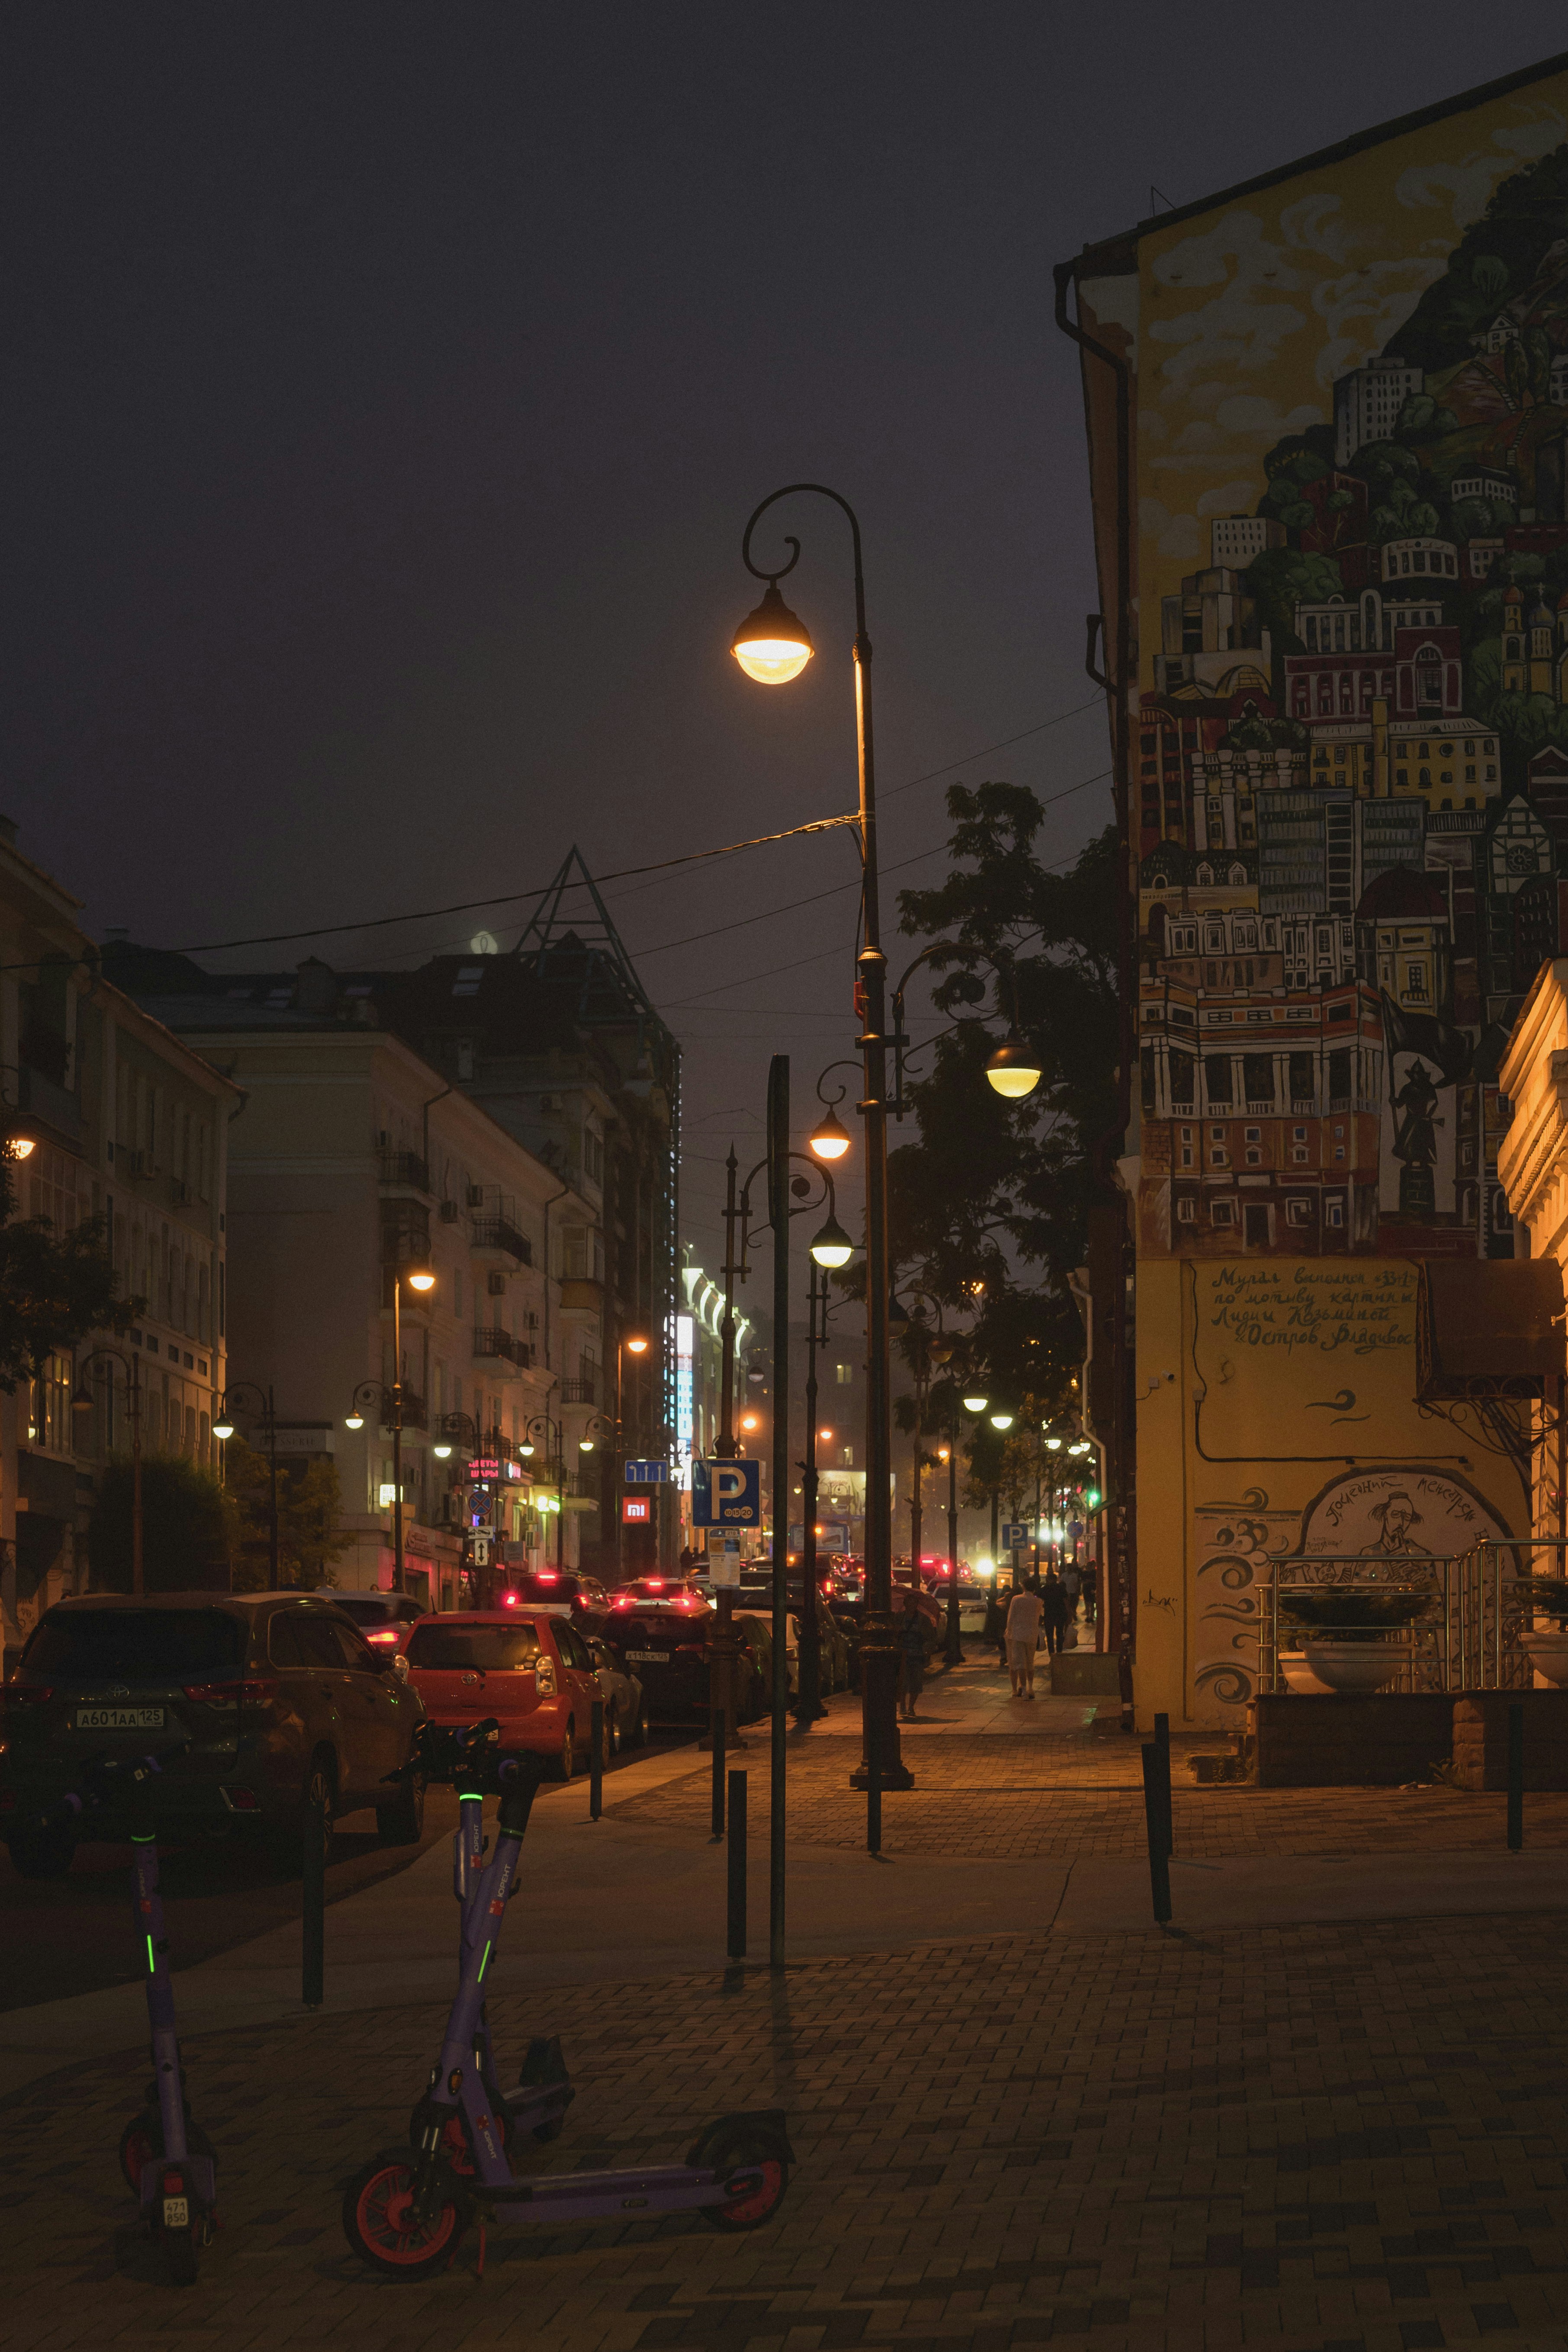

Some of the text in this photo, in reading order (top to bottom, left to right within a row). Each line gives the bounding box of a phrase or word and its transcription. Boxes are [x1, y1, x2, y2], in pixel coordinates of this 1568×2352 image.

[1212, 1266, 1281, 1293] Мурал
[1214, 1291, 1236, 1303] по
[1244, 1286, 1316, 1308] мотиву
[1211, 1306, 1276, 1334] Лидии
[1320, 1323, 1417, 1355] Владивос
[712, 1467, 747, 1519] P
[1009, 1526, 1023, 1547] P
[81, 1710, 160, 1725] А601АА 125
[498, 1863, 511, 1898] ЮРЕНТ
[484, 2130, 497, 2159] ЮРЕНТ
[167, 2202, 185, 2212] 471
